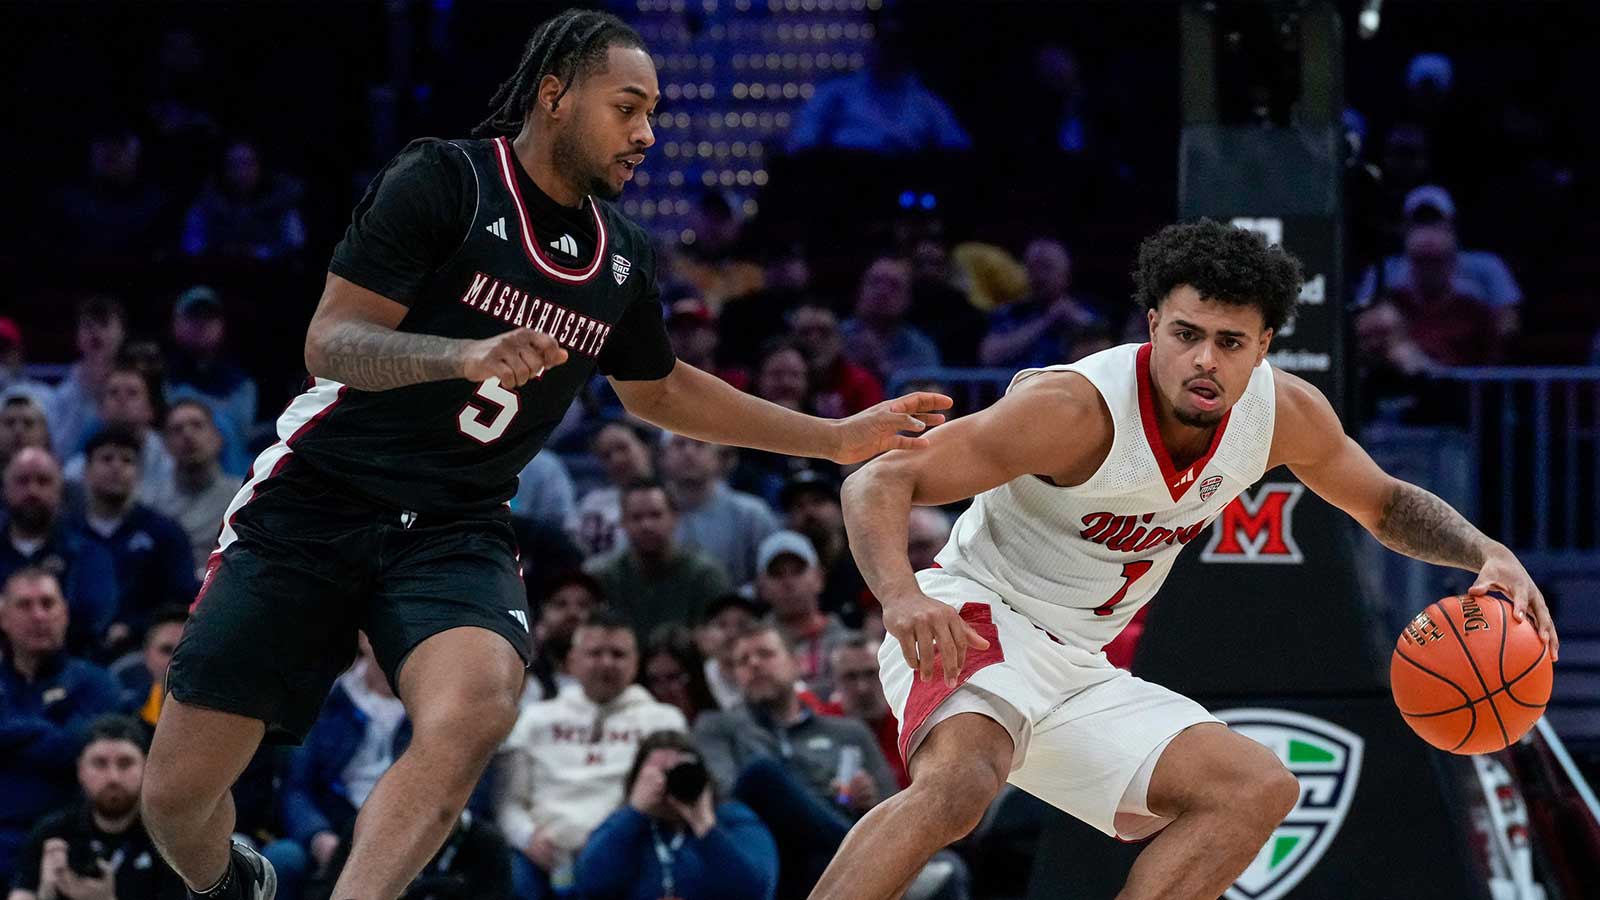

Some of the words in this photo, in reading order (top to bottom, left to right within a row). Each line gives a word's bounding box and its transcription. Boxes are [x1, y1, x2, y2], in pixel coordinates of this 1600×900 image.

[461, 271, 612, 356] MASSACHUSETTS
[328, 352, 427, 387] CHOSEN
[456, 368, 545, 447] 5
[1080, 512, 1209, 553] Miam
[1201, 482, 1303, 563] M
[1094, 560, 1154, 616] 1
[1458, 595, 1490, 632] DING
